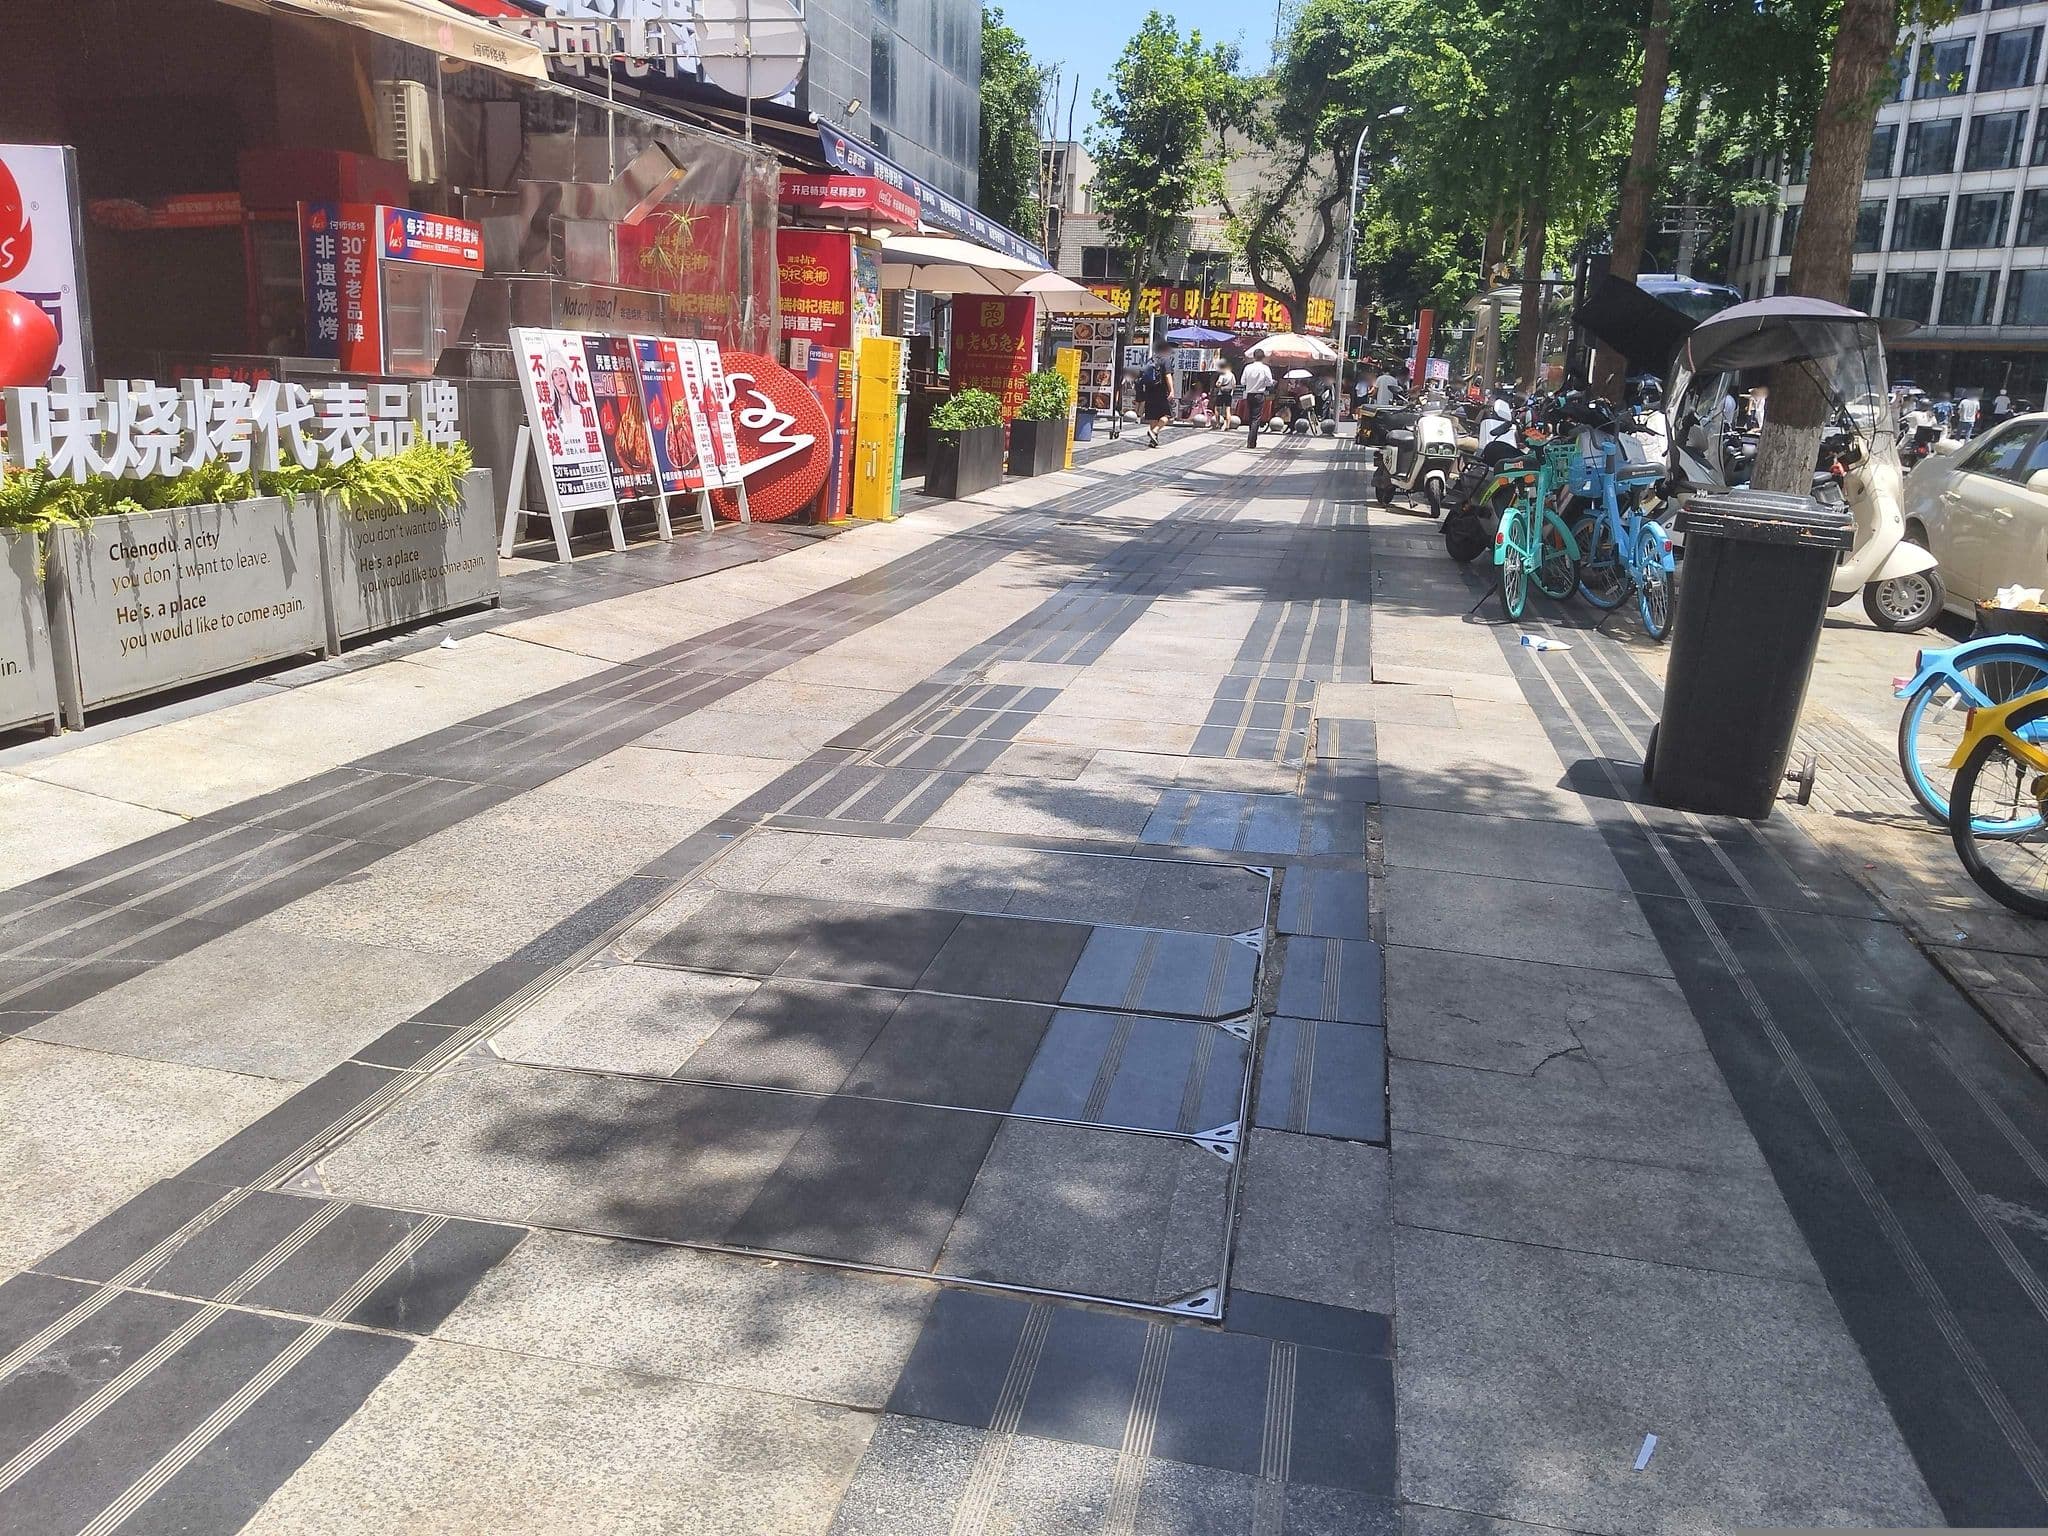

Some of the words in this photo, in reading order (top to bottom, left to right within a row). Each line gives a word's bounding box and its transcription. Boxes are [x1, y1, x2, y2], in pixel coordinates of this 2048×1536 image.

[315, 235, 339, 341] 非遗烧烤
[563, 297, 578, 316] Not
[578, 299, 592, 320] only
[594, 296, 618, 321] BBQ!
[569, 356, 602, 453] 不做加盟
[5, 377, 461, 485] 味烧烤代表品牌
[184, 537, 192, 550] a
[195, 531, 219, 550] city
[357, 533, 375, 550] you
[406, 523, 427, 538] want
[428, 520, 437, 533] to
[112, 572, 140, 596] you
[185, 561, 218, 579] want
[221, 557, 233, 572] to
[237, 552, 271, 569] leave.
[387, 556, 393, 567] a
[395, 549, 419, 569] place
[362, 581, 380, 598] you
[382, 570, 410, 590] would
[412, 567, 427, 582] like
[428, 566, 437, 579] to
[439, 561, 461, 576] come
[158, 603, 166, 617] a
[170, 594, 206, 619] place
[121, 634, 147, 657] you
[151, 618, 193, 645] would
[196, 615, 218, 635] like
[221, 614, 234, 629] to
[237, 607, 270, 625] come
